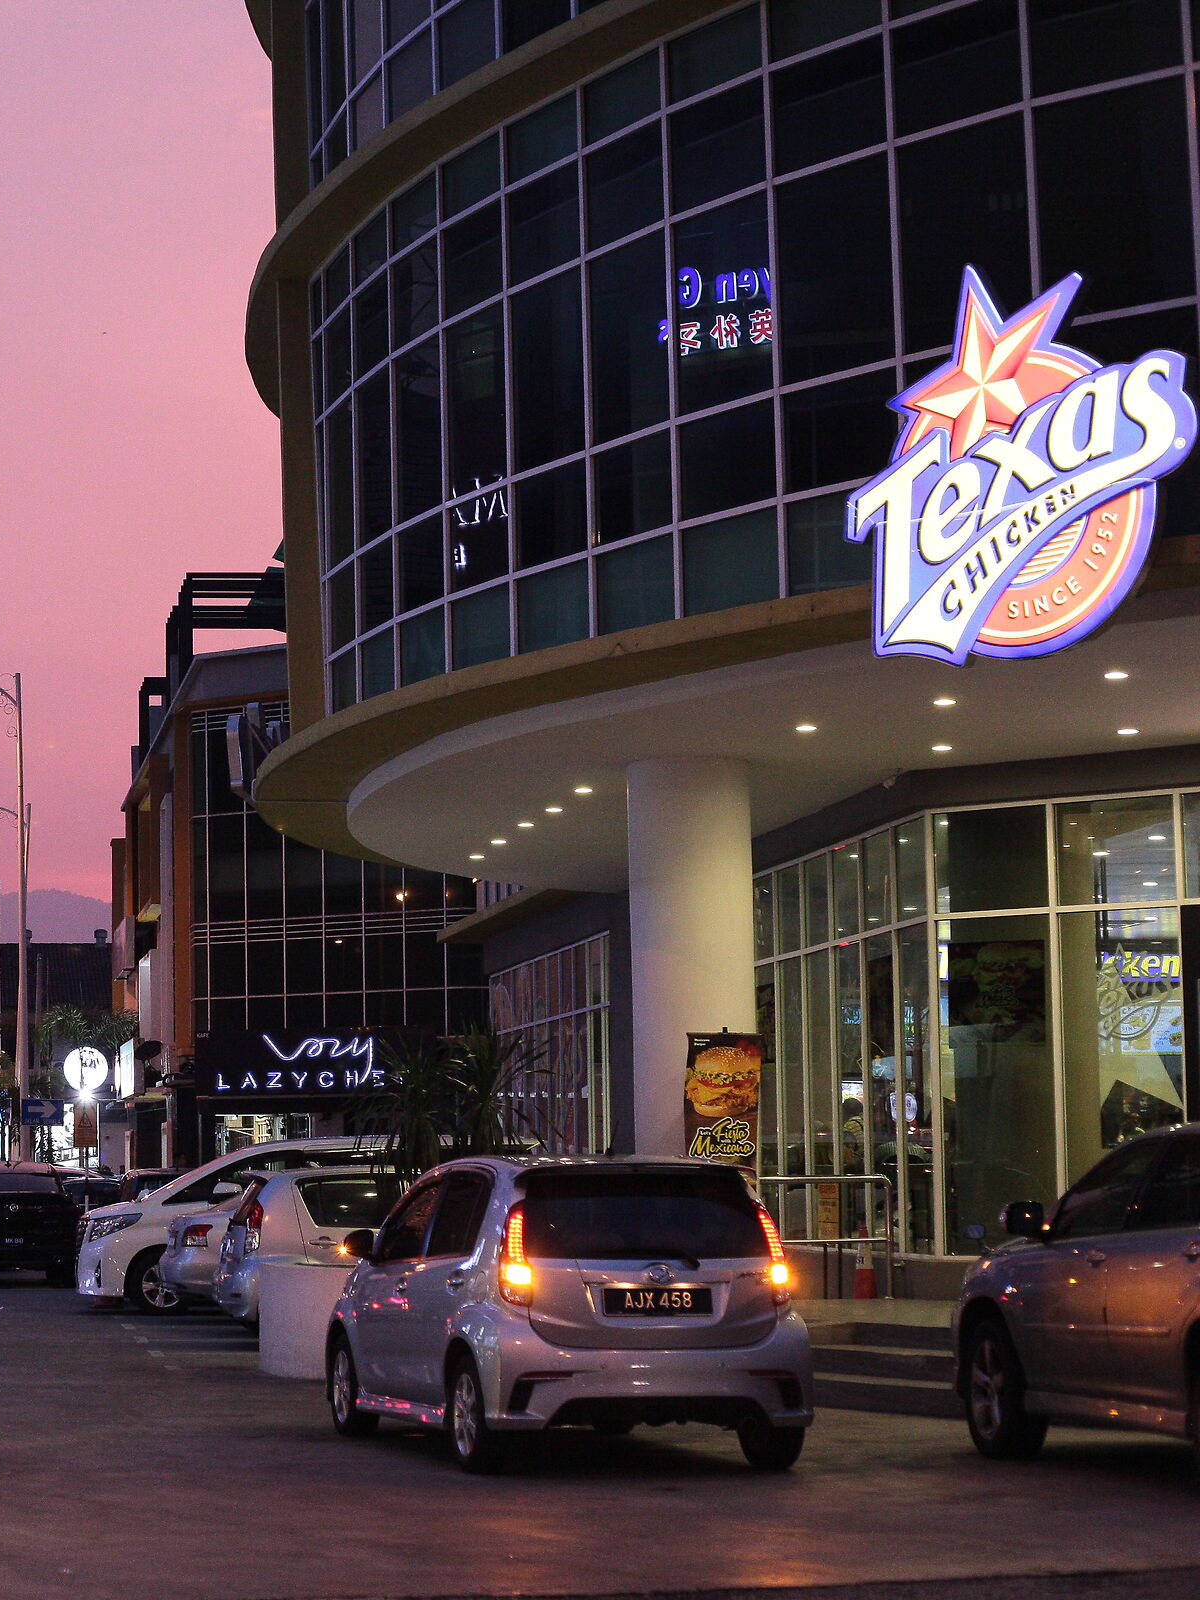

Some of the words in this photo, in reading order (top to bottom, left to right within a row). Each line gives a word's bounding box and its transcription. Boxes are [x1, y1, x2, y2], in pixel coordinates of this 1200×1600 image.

[855, 355, 1178, 634] Texas
[939, 482, 1077, 622] CHICKEN
[1008, 575, 1083, 620] SINCE
[1086, 510, 1119, 572] 1952
[216, 1069, 404, 1091] LAZYCHE
[712, 1120, 748, 1143] Fiesta
[691, 1135, 753, 1156] Mexicana
[624, 1291, 656, 1309] AJX
[659, 1291, 694, 1309] 458
